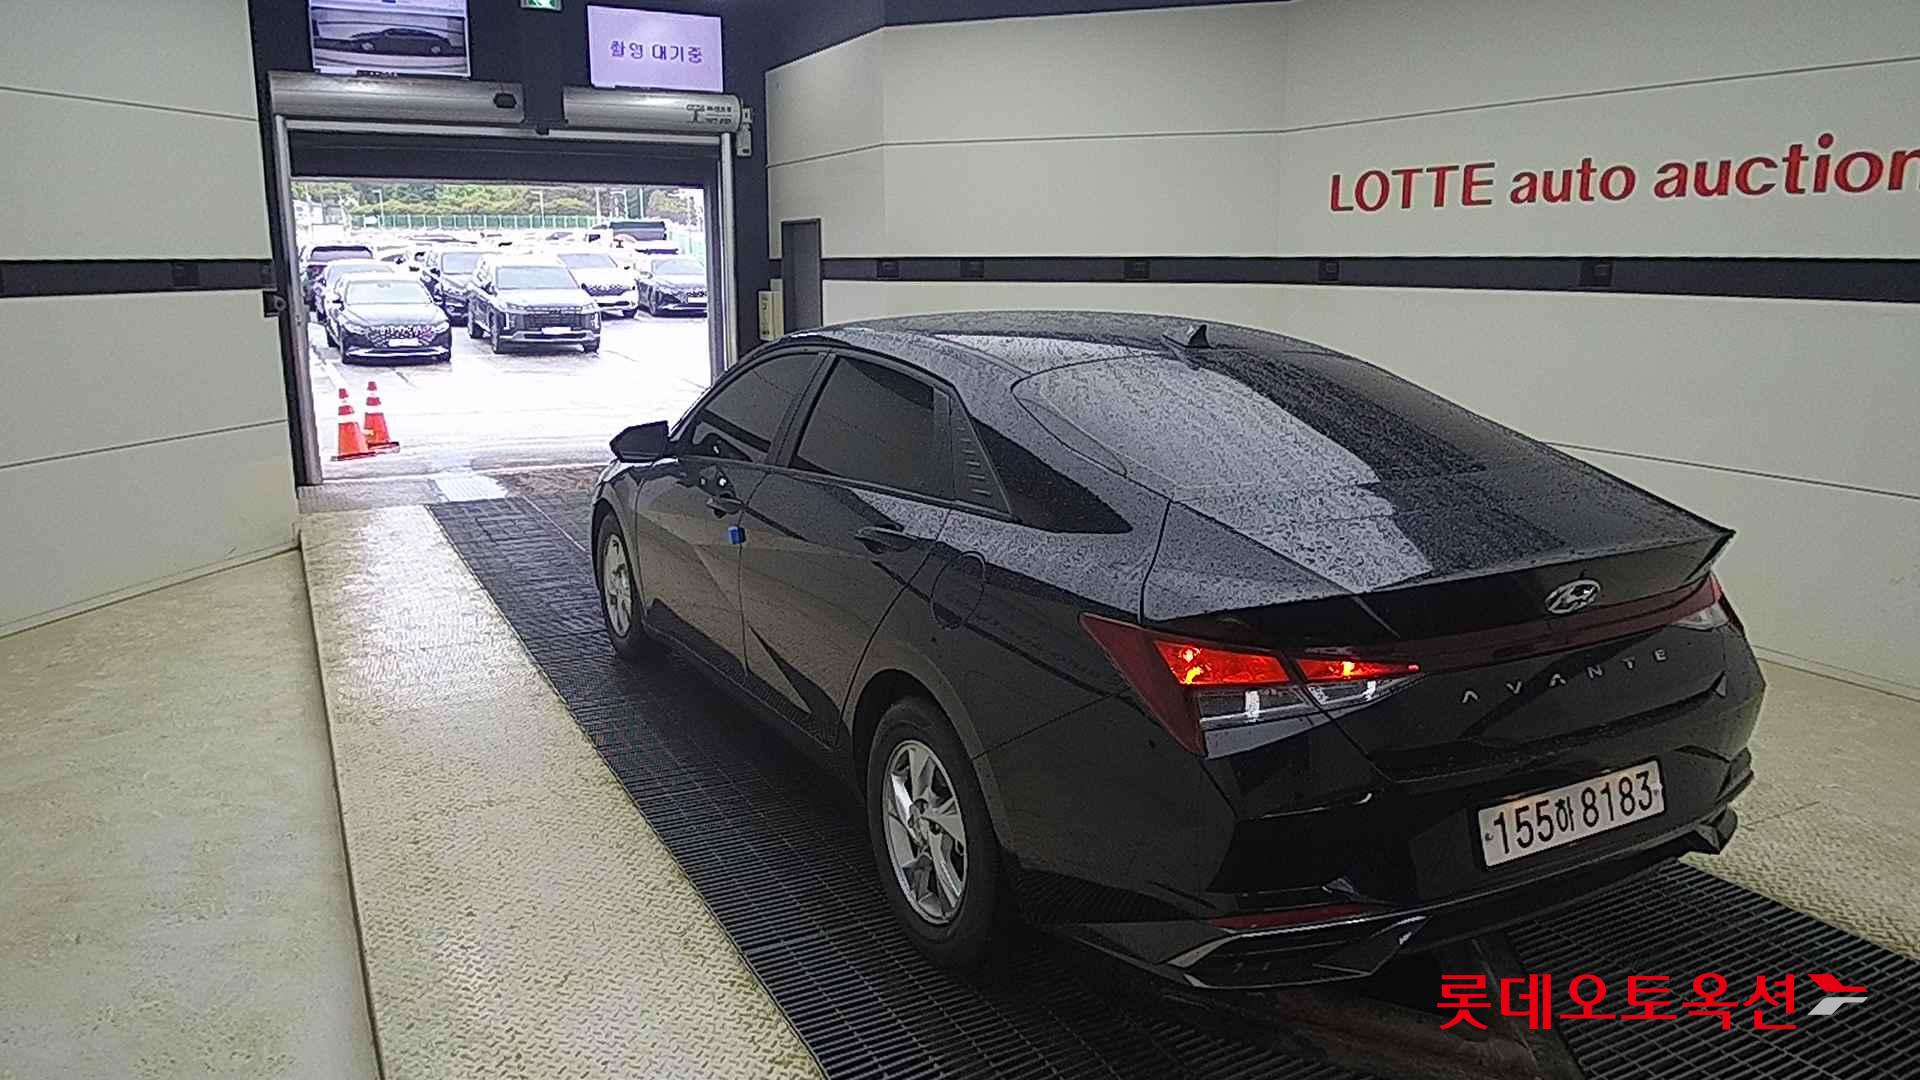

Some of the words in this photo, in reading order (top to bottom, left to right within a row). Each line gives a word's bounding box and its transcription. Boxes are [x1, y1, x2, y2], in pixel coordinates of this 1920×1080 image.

[651, 43, 703, 64] 대기중
[1329, 161, 1496, 213] LOTTE
[1509, 156, 1637, 205] auto
[1653, 132, 1920, 199] auction
[1461, 648, 1668, 704] AVANTE
